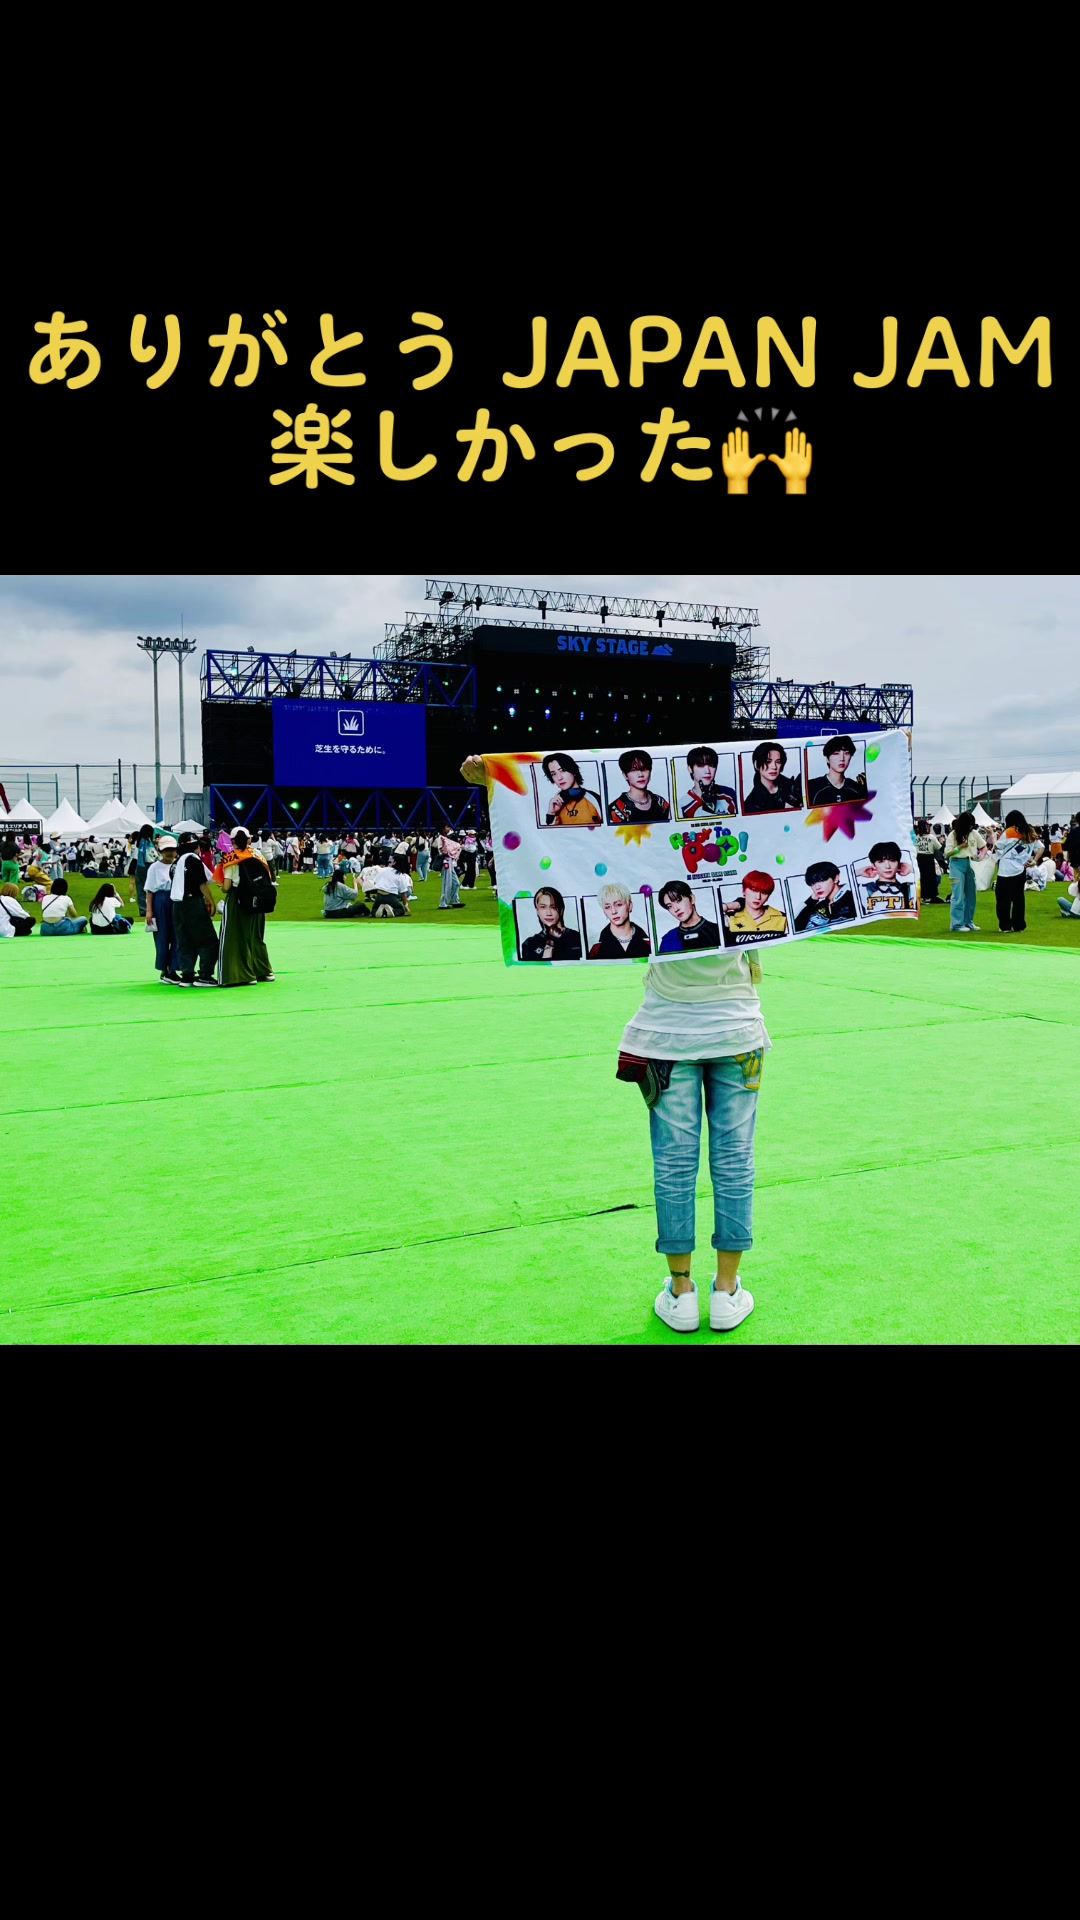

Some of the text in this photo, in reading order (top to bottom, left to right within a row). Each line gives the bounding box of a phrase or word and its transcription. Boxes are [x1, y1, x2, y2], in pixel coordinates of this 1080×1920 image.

[557, 635, 649, 656] SKY STAGE
[314, 744, 386, 755] 芝生を守るために。
[714, 826, 731, 839] TO
